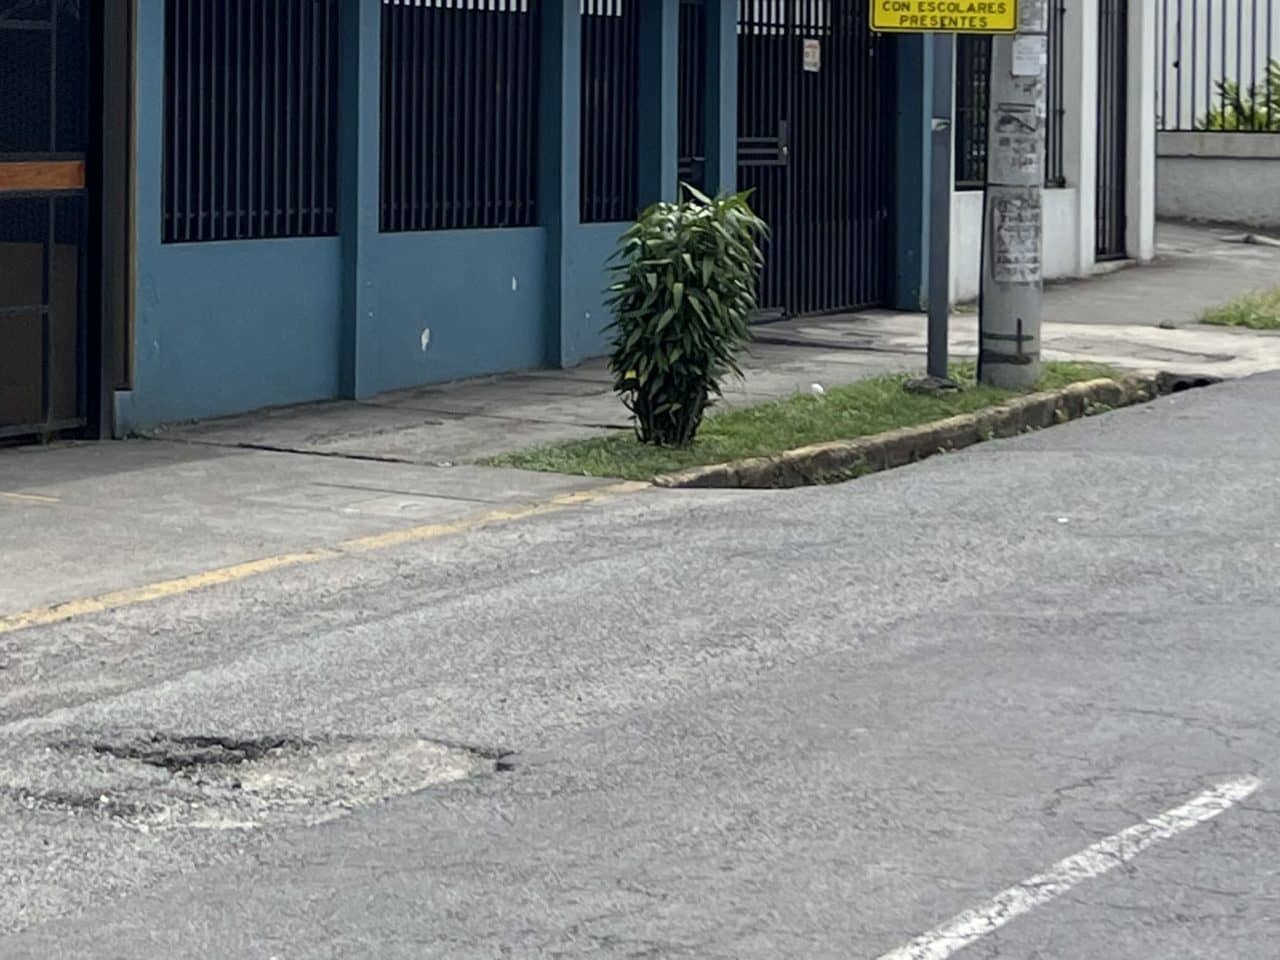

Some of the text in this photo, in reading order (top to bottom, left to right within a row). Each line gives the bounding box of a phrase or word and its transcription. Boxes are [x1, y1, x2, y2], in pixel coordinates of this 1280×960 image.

[882, 1, 1007, 14] CON ESCOLARES
[899, 15, 988, 28] PRESENTES
